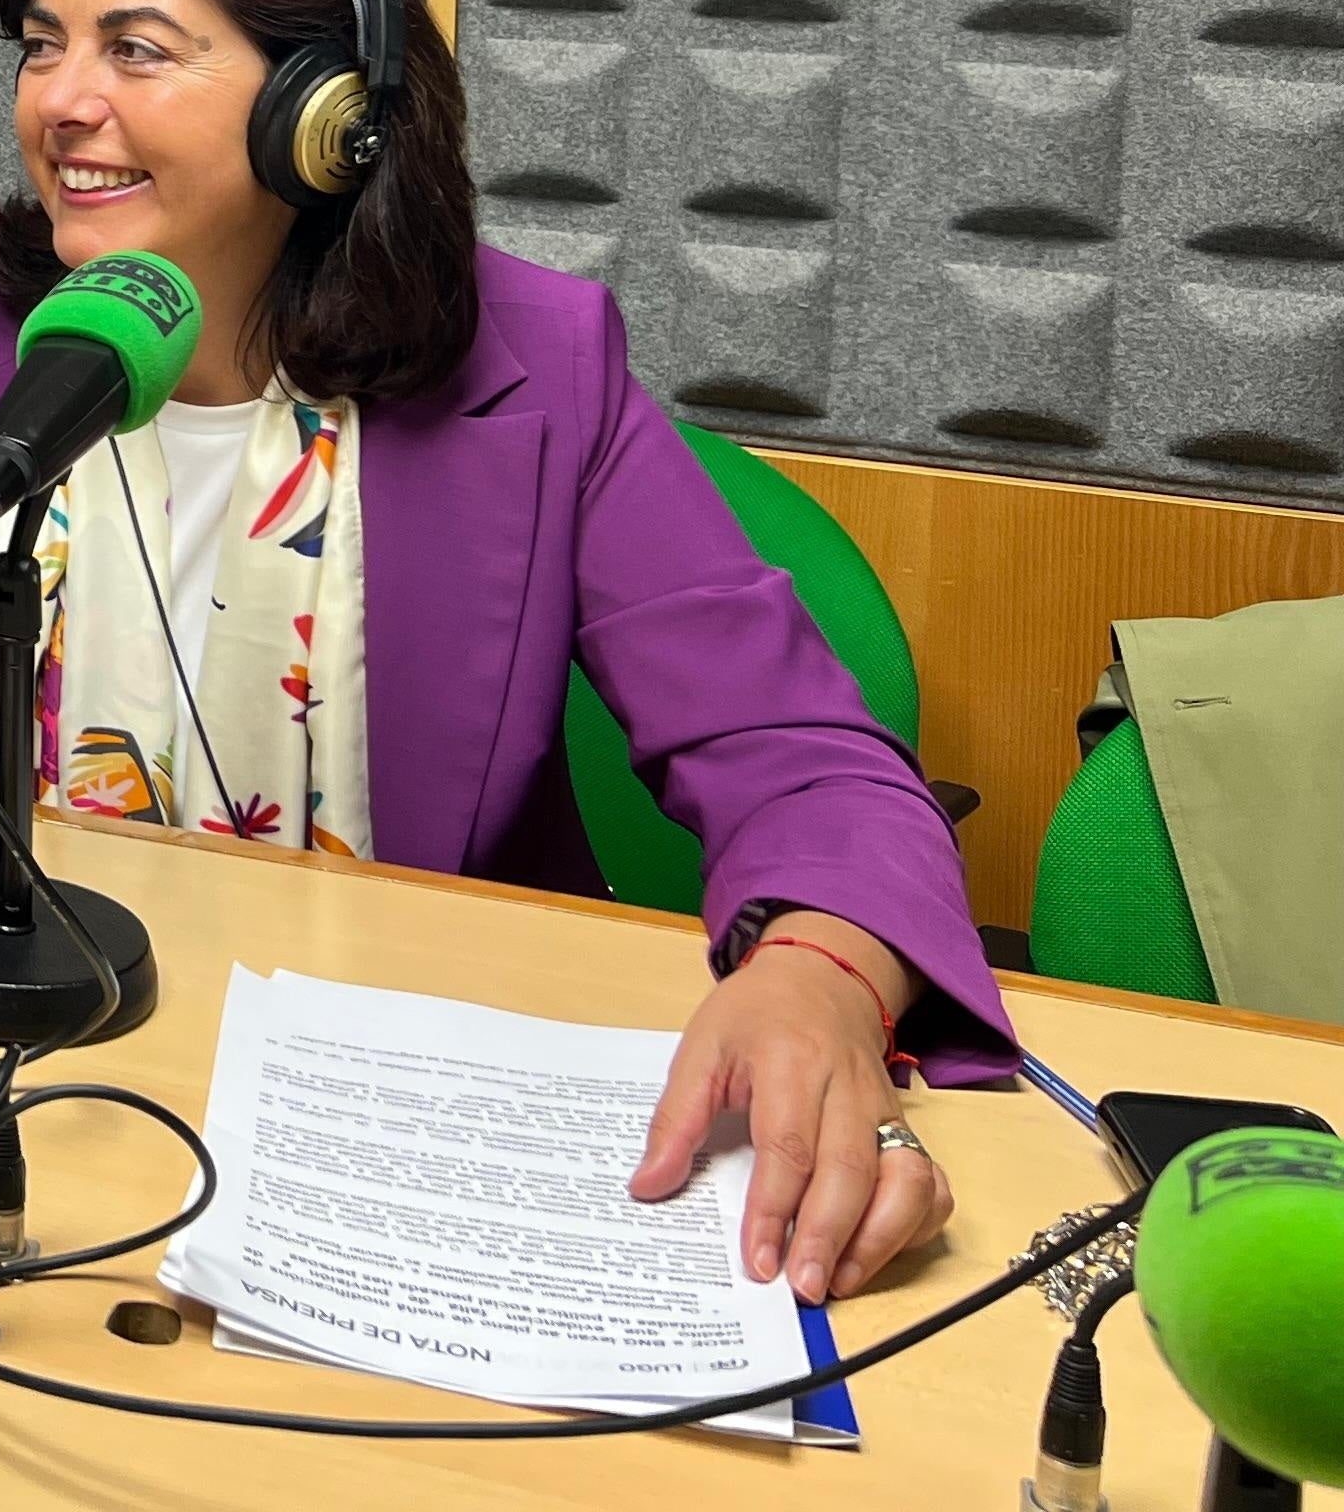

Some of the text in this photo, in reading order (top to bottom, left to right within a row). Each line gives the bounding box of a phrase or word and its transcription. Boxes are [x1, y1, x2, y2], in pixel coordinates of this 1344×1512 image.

[80, 262, 174, 298] ONDA
[240, 1279, 491, 1363] NOTA DE PRENSA
[618, 1362, 682, 1373] LUGO
